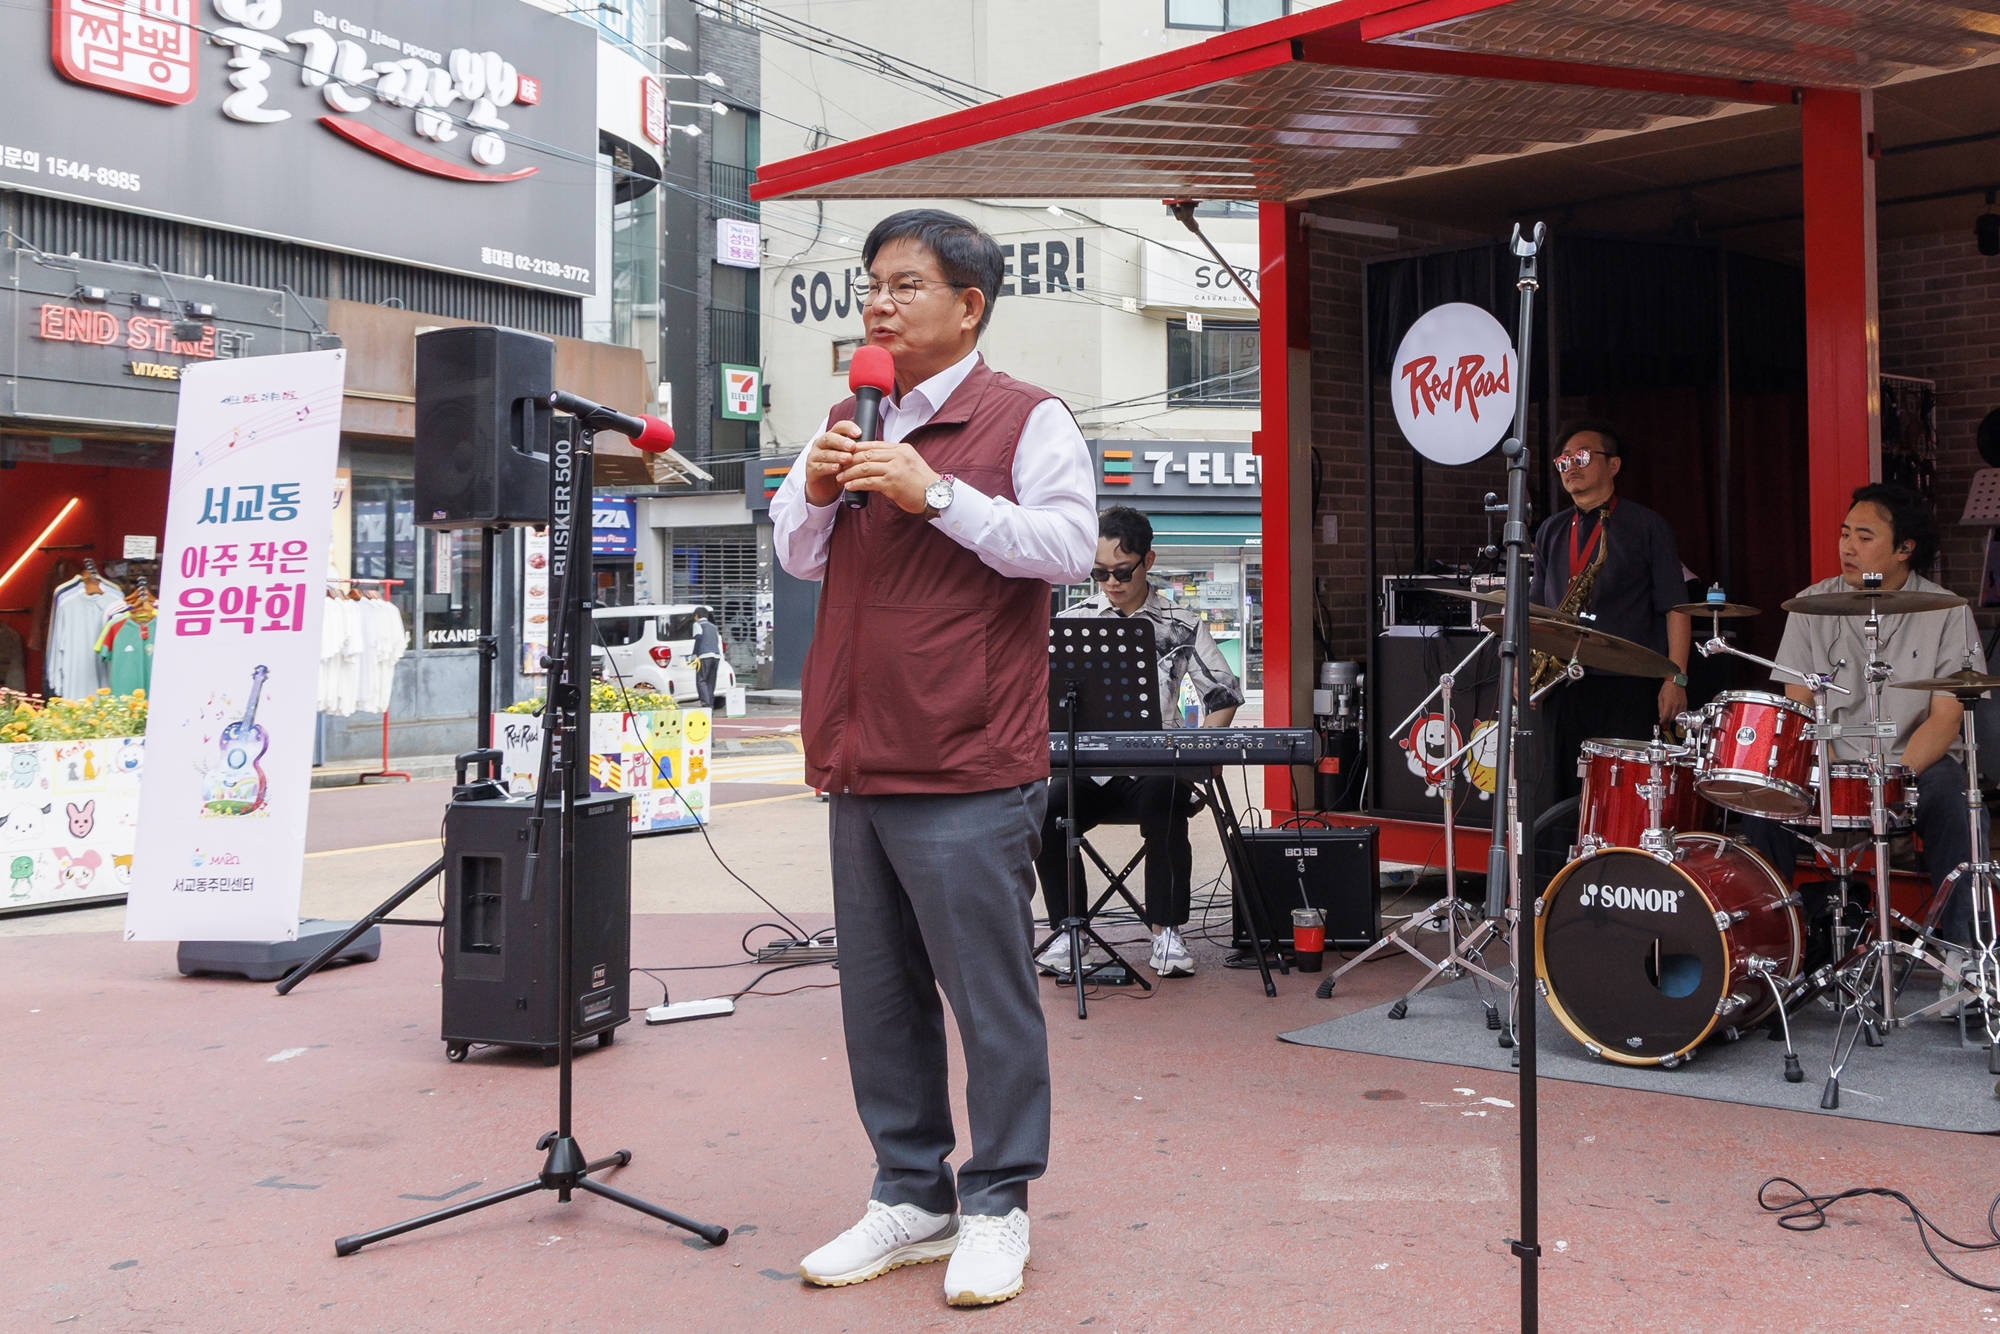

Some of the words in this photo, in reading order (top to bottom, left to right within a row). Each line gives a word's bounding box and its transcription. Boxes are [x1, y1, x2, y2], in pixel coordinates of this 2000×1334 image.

[313, 9, 337, 31] Bul
[339, 18, 367, 40] Gan
[403, 42, 442, 65] ppong
[0, 145, 40, 173] 문의
[46, 156, 141, 192] 1544-8985
[730, 233, 755, 248] 성인
[481, 246, 514, 269] 홍대점
[515, 254, 590, 283] 02-2138-3772
[1194, 294, 1228, 302] CASUAL
[40, 303, 120, 346] END
[131, 360, 179, 381] VITAGE
[1401, 355, 1454, 420] Red
[1454, 352, 1510, 423] Road
[555, 439, 572, 483] 500
[1144, 451, 1262, 485] 7-ELE
[196, 482, 301, 525] 서교동
[180, 543, 239, 579] 아주
[248, 540, 308, 575] 작은
[175, 582, 306, 637] 음악회
[428, 628, 481, 644] KKANB
[1285, 847, 1318, 857] BOSS
[172, 877, 255, 892] 서교동주민센터
